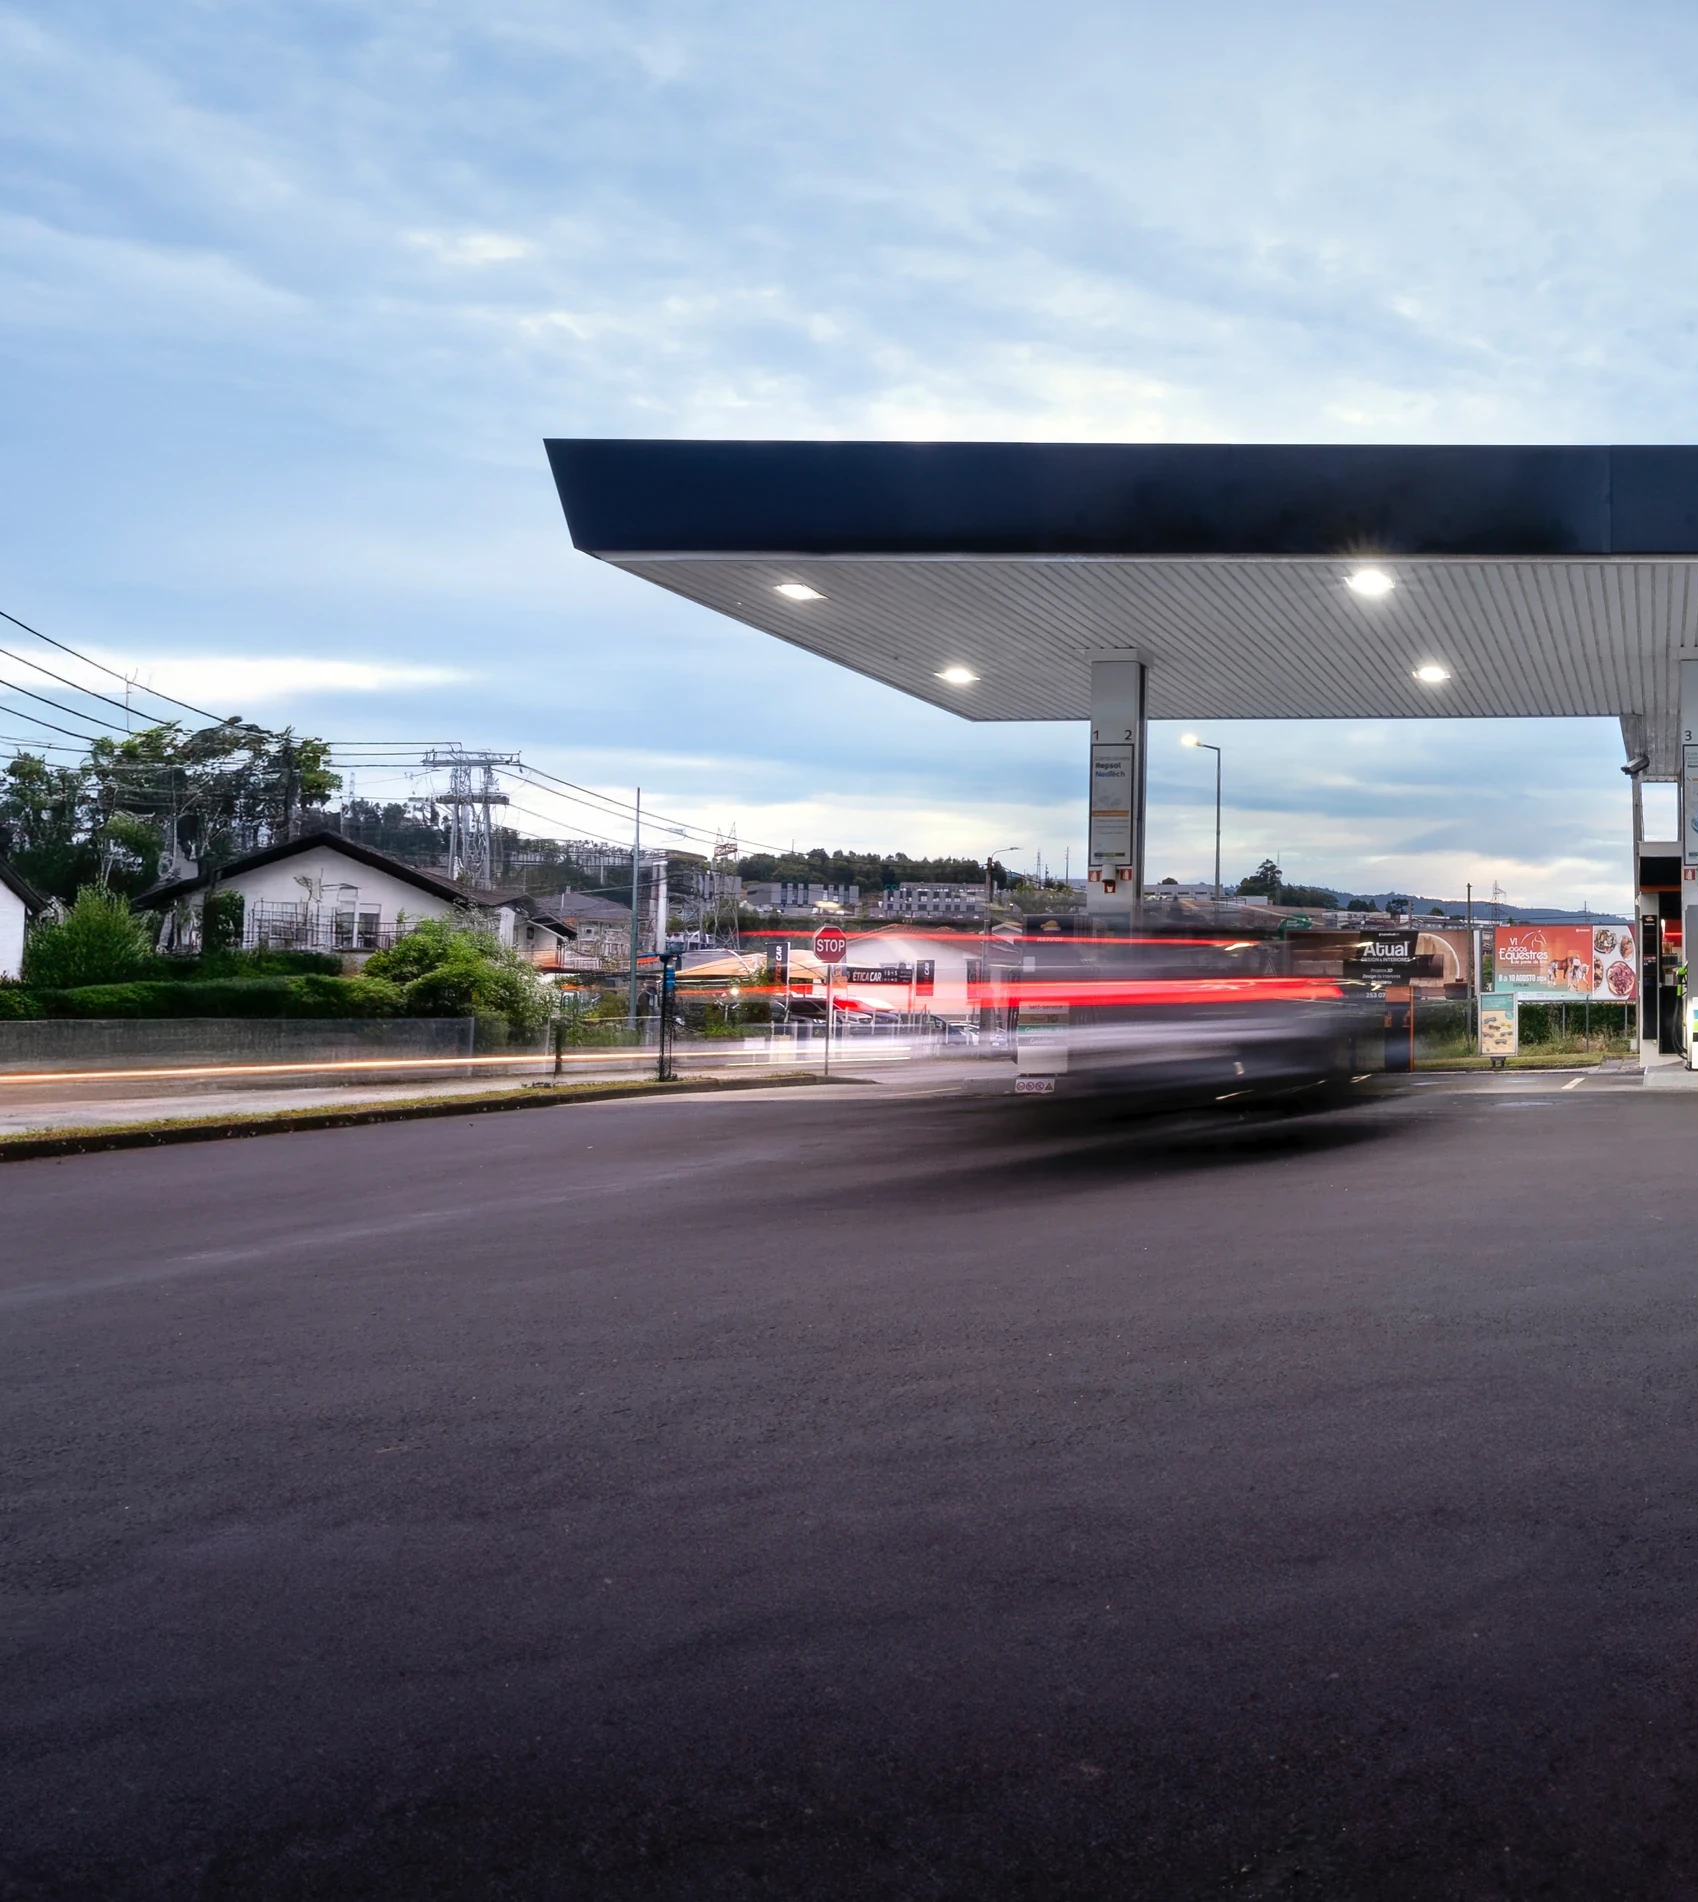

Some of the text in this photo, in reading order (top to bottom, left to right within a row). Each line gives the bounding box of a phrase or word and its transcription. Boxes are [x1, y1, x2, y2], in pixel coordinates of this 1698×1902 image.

[1093, 729, 1132, 741] 1 2
[1684, 730, 1692, 741] 3
[1095, 762, 1121, 770] Repsol
[816, 938, 846, 952] STOP
[1509, 937, 1518, 946] VI
[1363, 941, 1409, 957] Atual
[1498, 947, 1548, 964] Equestres
[852, 970, 869, 981] ÉTICA
[869, 971, 882, 982] CAR
[1509, 974, 1515, 982] 10
[1516, 974, 1536, 982] AGOSTO
